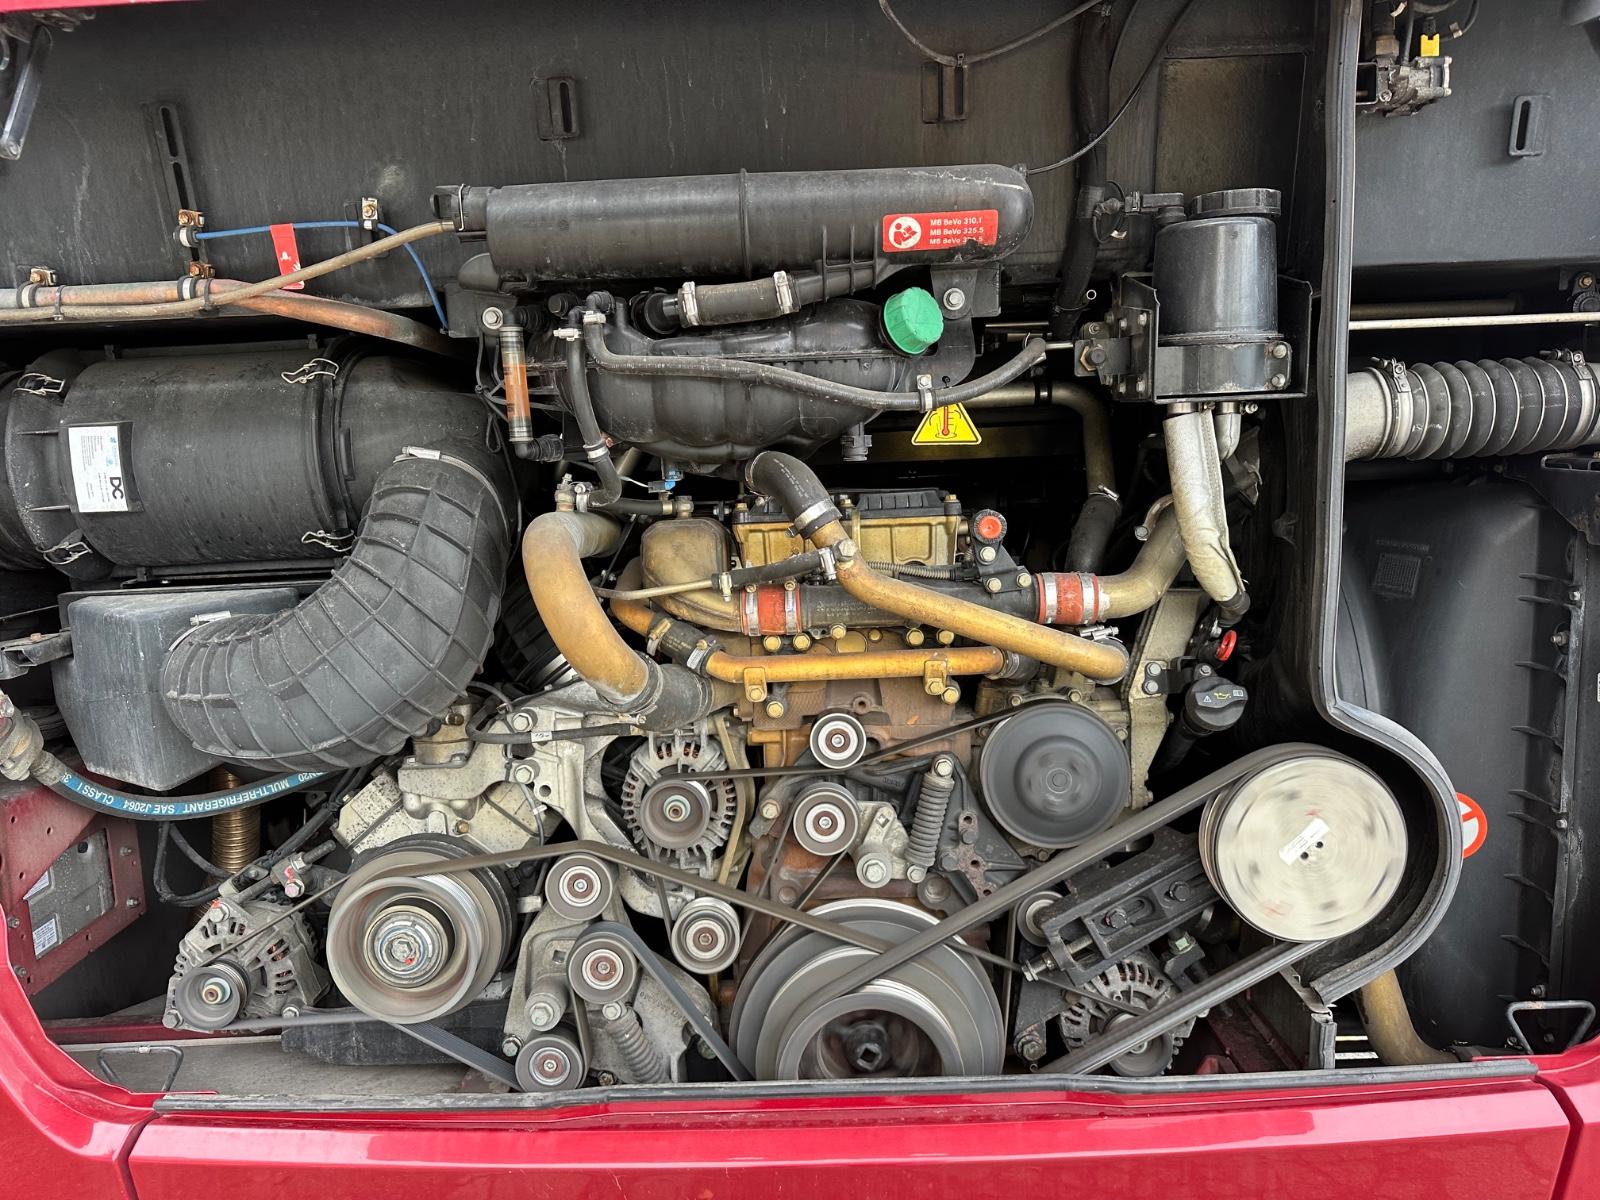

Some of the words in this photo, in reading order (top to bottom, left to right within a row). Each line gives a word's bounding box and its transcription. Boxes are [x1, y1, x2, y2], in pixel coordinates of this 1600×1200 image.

[943, 218, 962, 226] BeVo
[963, 217, 982, 225] 310.1
[82, 784, 115, 805] CLASS
[182, 778, 290, 813] MULTI-REFRIGERANT
[123, 799, 152, 811] J2064
[152, 804, 175, 814] SAE
